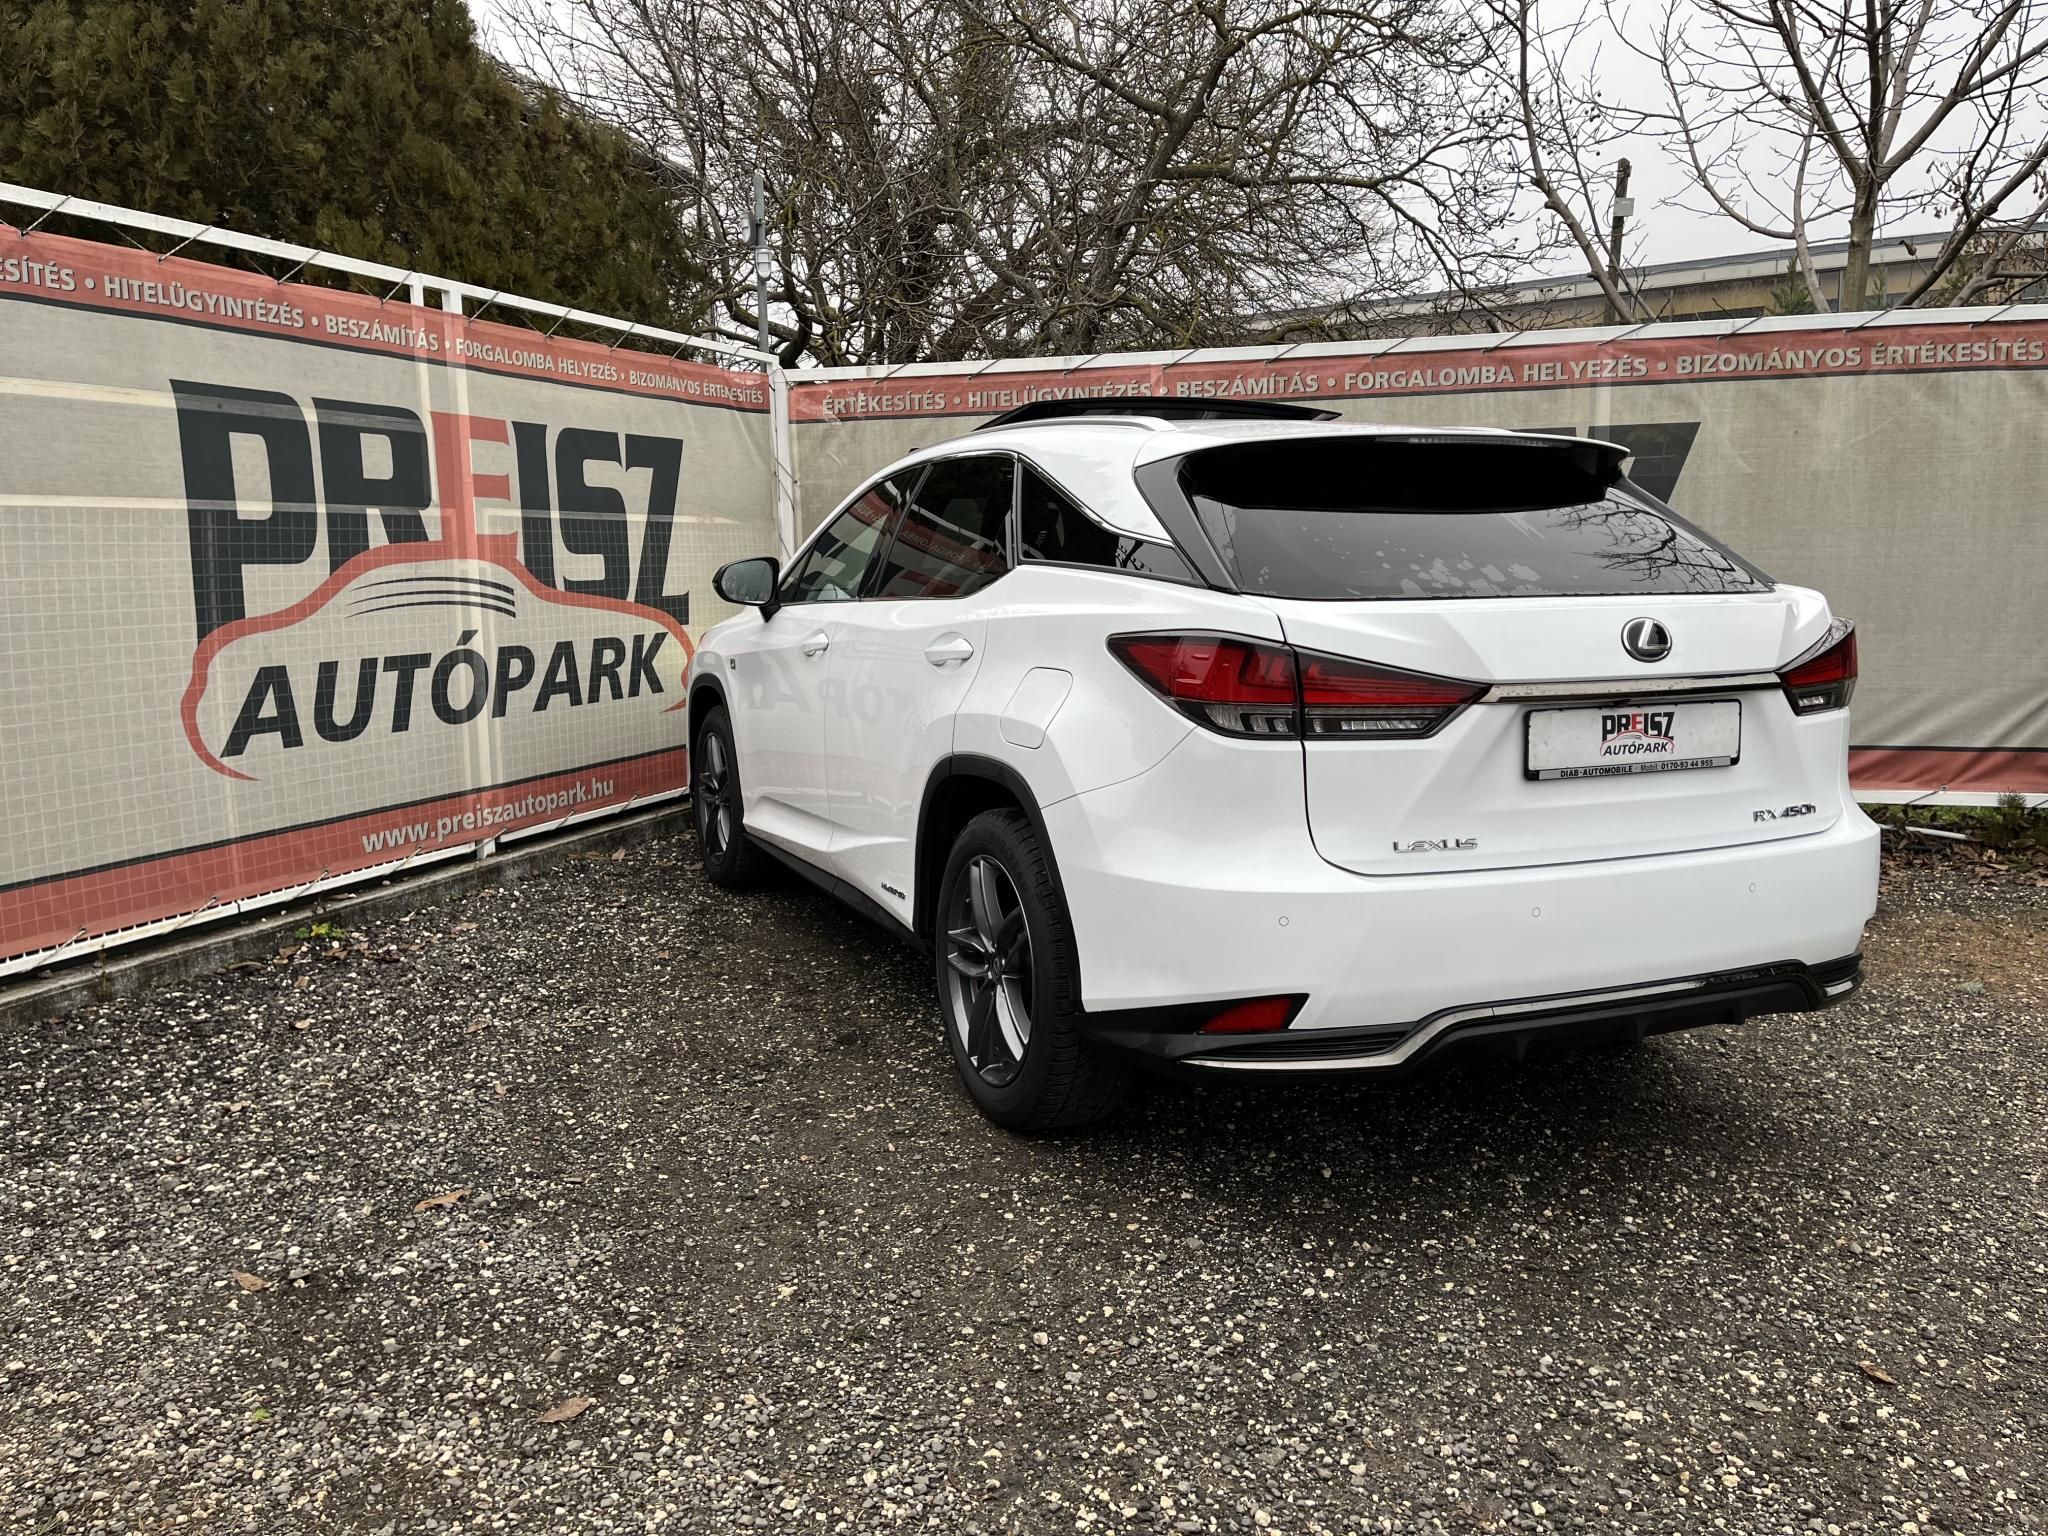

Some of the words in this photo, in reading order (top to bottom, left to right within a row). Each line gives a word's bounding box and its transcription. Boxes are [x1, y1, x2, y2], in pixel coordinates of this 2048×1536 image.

[0, 254, 77, 292] SÍTÉS
[104, 275, 305, 328] HITELÜGYINTÉZÉS
[325, 312, 440, 352] BESZÁMÍTÁS
[456, 337, 555, 372] FORGALOMBA
[557, 356, 619, 382] HELYEZÉS
[629, 369, 701, 395] BIZOMÁNYOS
[821, 392, 946, 415] ÉRTÉKESÍTÉS
[967, 380, 1153, 409] HITELÜGYINTÉZÉS
[1175, 370, 1319, 398] BESZÁMÍTÁS
[1345, 364, 1515, 392] FORGALOMBA
[1523, 354, 1648, 382] HELYEZÉS
[1676, 347, 1862, 375] BIZOMÁNYOS
[1871, 338, 2046, 366] ÉRTÉKESÍTÉS
[169, 378, 690, 646] PREISZ
[219, 629, 670, 759] AUTÓPARK
[1601, 711, 1675, 743] PREISZ
[1603, 741, 1669, 757] AUTÓPARK
[1560, 765, 1633, 778] DIAB-AUTOMOBILE
[1661, 761, 1688, 770] 0170-93
[1690, 760, 1699, 768] 44
[361, 777, 615, 853] www.preiszautopark.hu
[1753, 808, 1777, 822] RX
[1780, 804, 1816, 817] 450h
[1393, 838, 1478, 853] LEXUS
